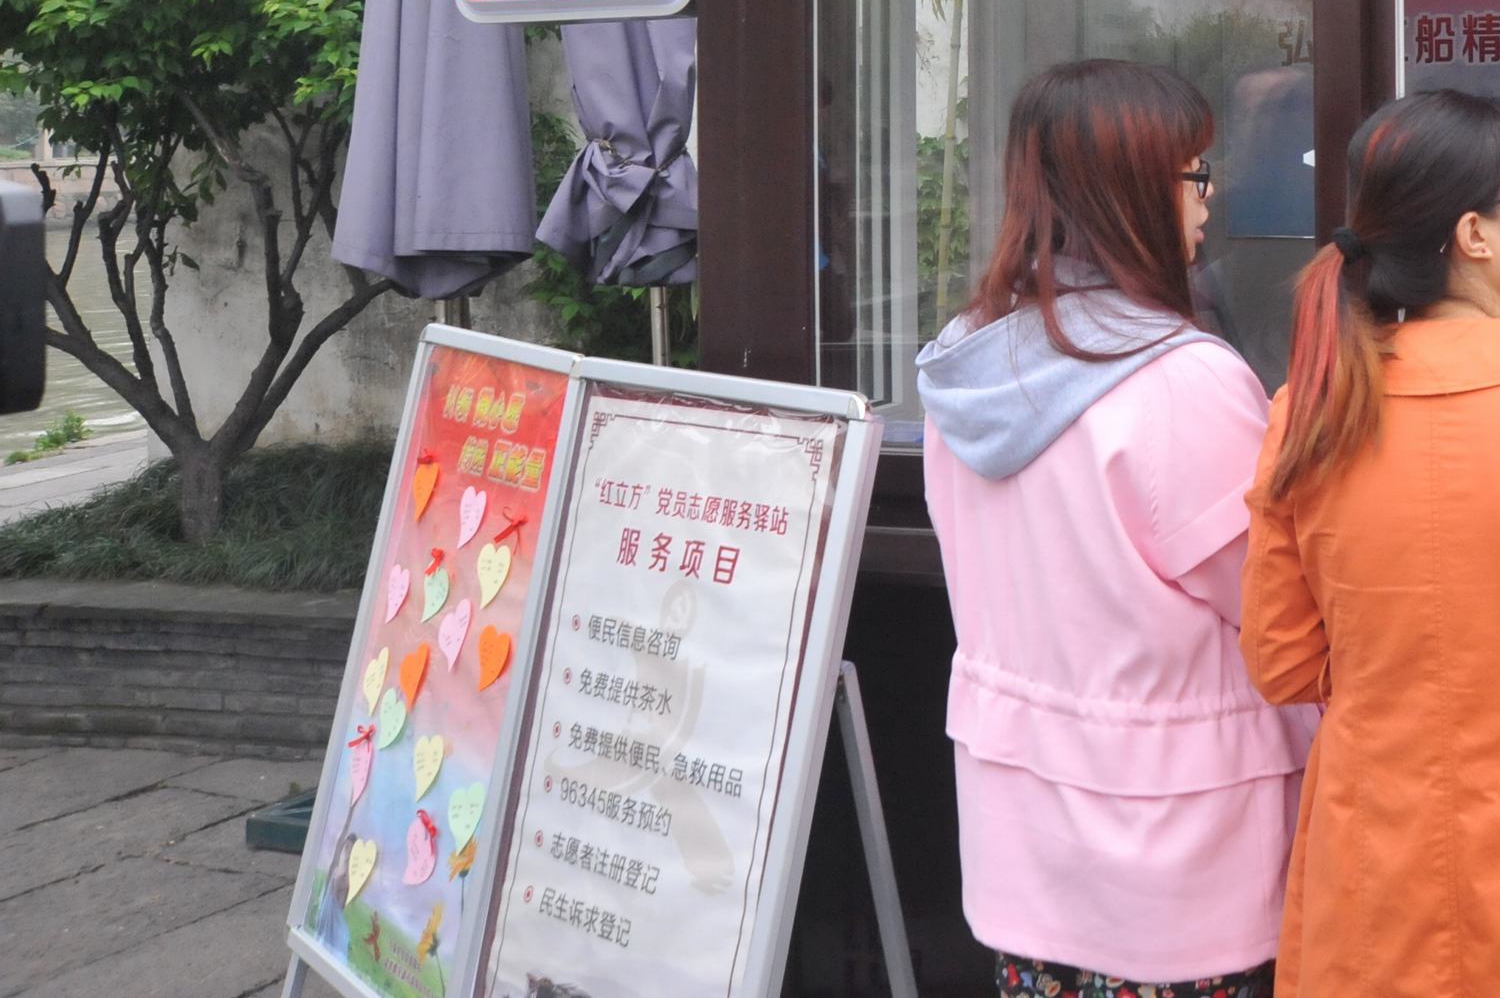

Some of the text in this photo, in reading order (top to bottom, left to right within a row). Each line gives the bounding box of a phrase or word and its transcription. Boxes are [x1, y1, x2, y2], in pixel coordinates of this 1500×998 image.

[616, 527, 741, 585] 服务项目
[587, 614, 683, 661] 便民信息咨询
[578, 667, 673, 716] 免费提供茶水
[568, 720, 745, 799] 免费提供便民、急救用品
[560, 777, 673, 838] 96345服务预约
[550, 832, 661, 896] 志愿者注册登记
[538, 886, 632, 949] 民生诉求登记
